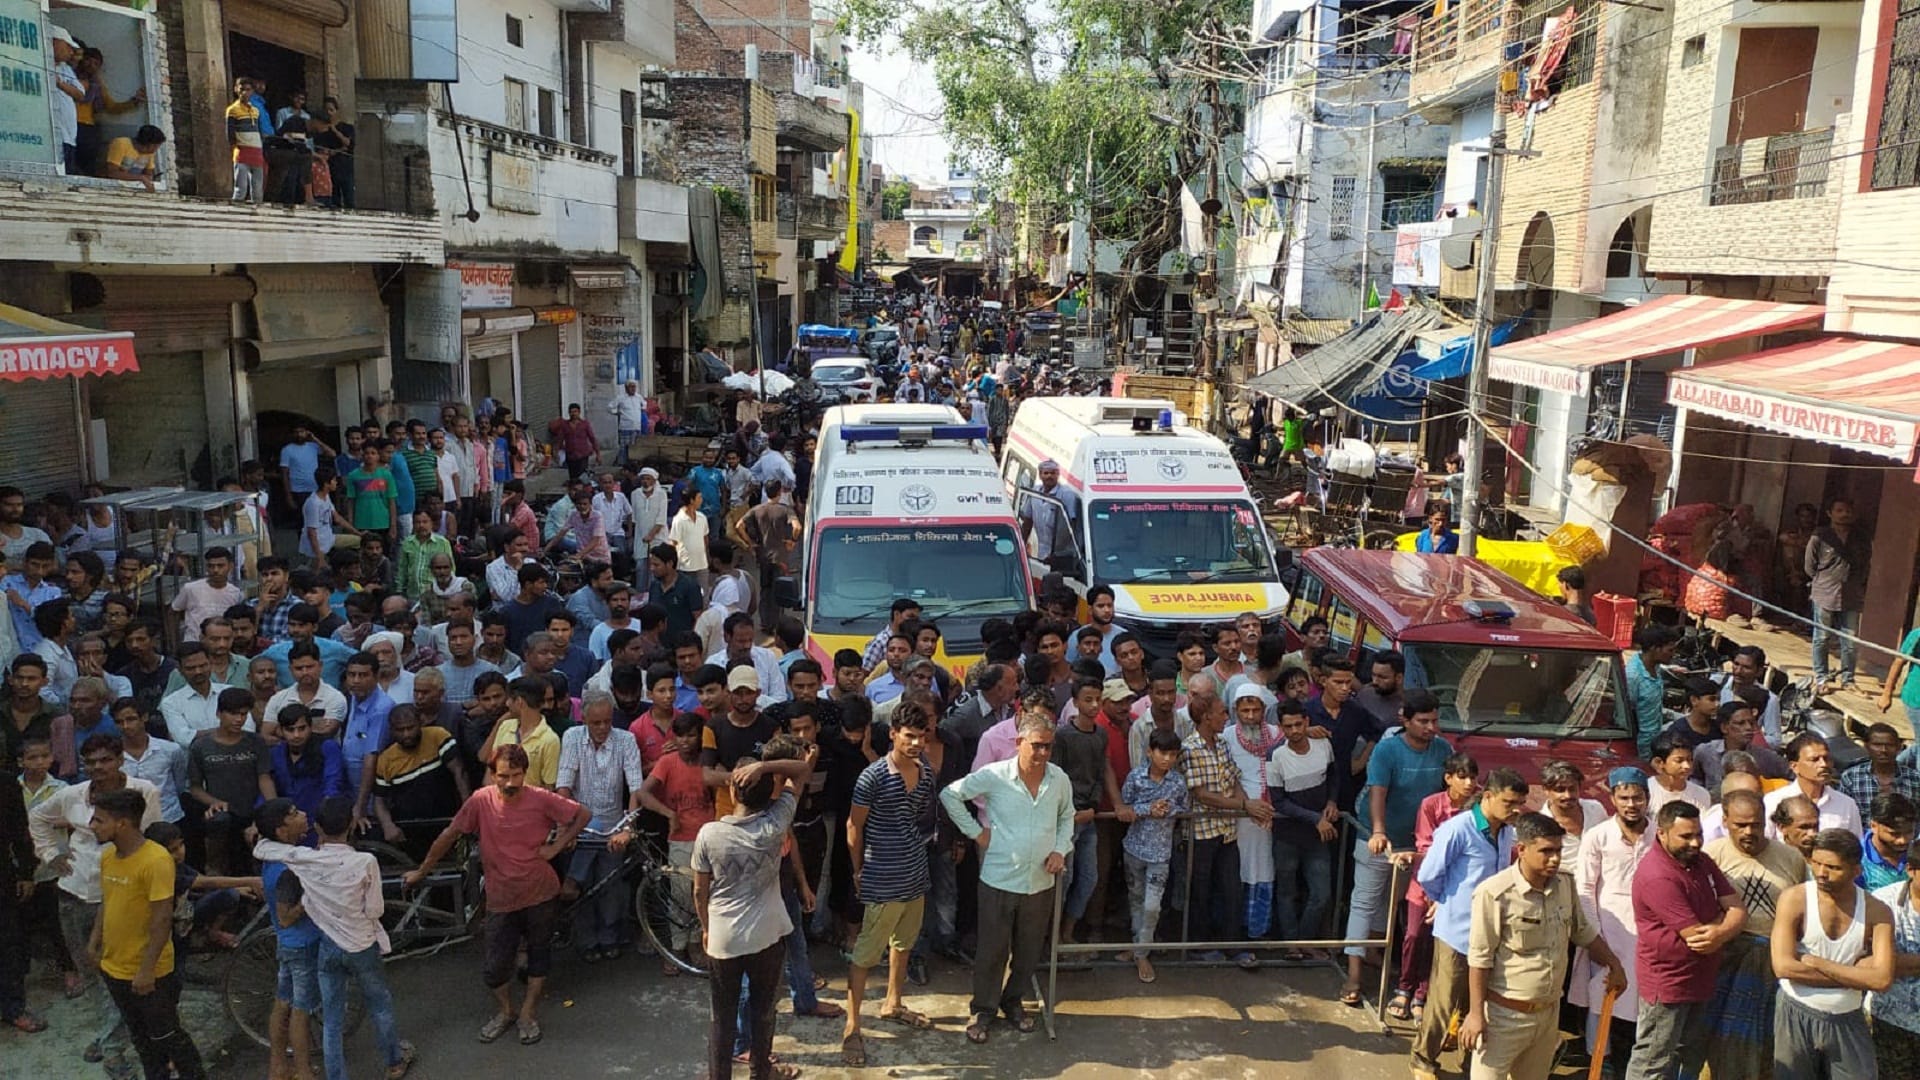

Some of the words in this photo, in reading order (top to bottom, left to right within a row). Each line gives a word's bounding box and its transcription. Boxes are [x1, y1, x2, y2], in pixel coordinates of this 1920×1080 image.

[1674, 383, 1764, 418] ALLAHABAD
[1770, 403, 1897, 448] FURNITURE
[1097, 458, 1125, 474] 108
[839, 486, 871, 504] 108
